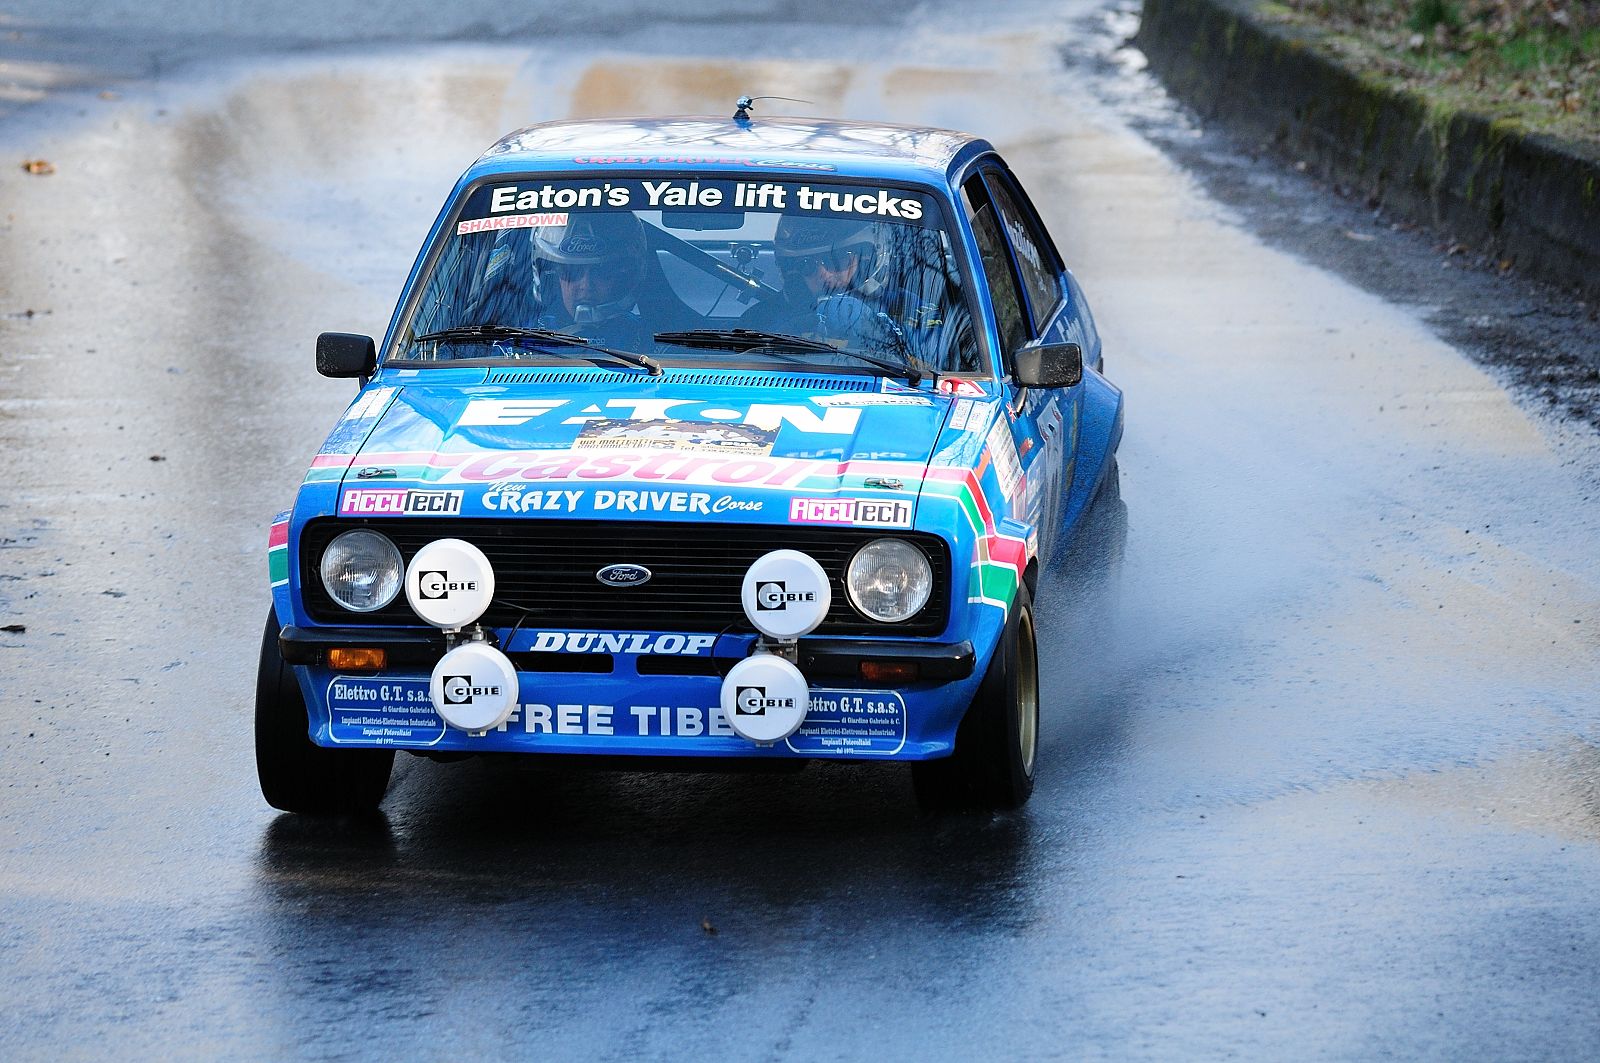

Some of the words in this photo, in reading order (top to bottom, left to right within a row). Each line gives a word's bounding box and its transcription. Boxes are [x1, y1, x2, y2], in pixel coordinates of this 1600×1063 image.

[490, 183, 630, 213] Eaton's
[641, 181, 723, 207] Yale
[734, 182, 787, 208] lift
[796, 186, 923, 220] trucks
[459, 214, 568, 235] SHAKEDOWN
[455, 398, 864, 435] EATON
[459, 453, 813, 486] Castrol
[487, 480, 528, 493] New
[481, 489, 585, 514] CRAZY
[593, 490, 712, 516] DRIVER
[711, 494, 765, 514] Corse
[609, 567, 639, 582] Ford
[529, 631, 717, 655] DUNLOP
[334, 684, 378, 701] Elettro
[380, 685, 404, 702] G.T.
[807, 696, 838, 713] ettro
[840, 697, 864, 714] G.T.
[867, 700, 899, 714] s.a.s.
[497, 703, 615, 736] FREE
[630, 705, 736, 737] TIBE
